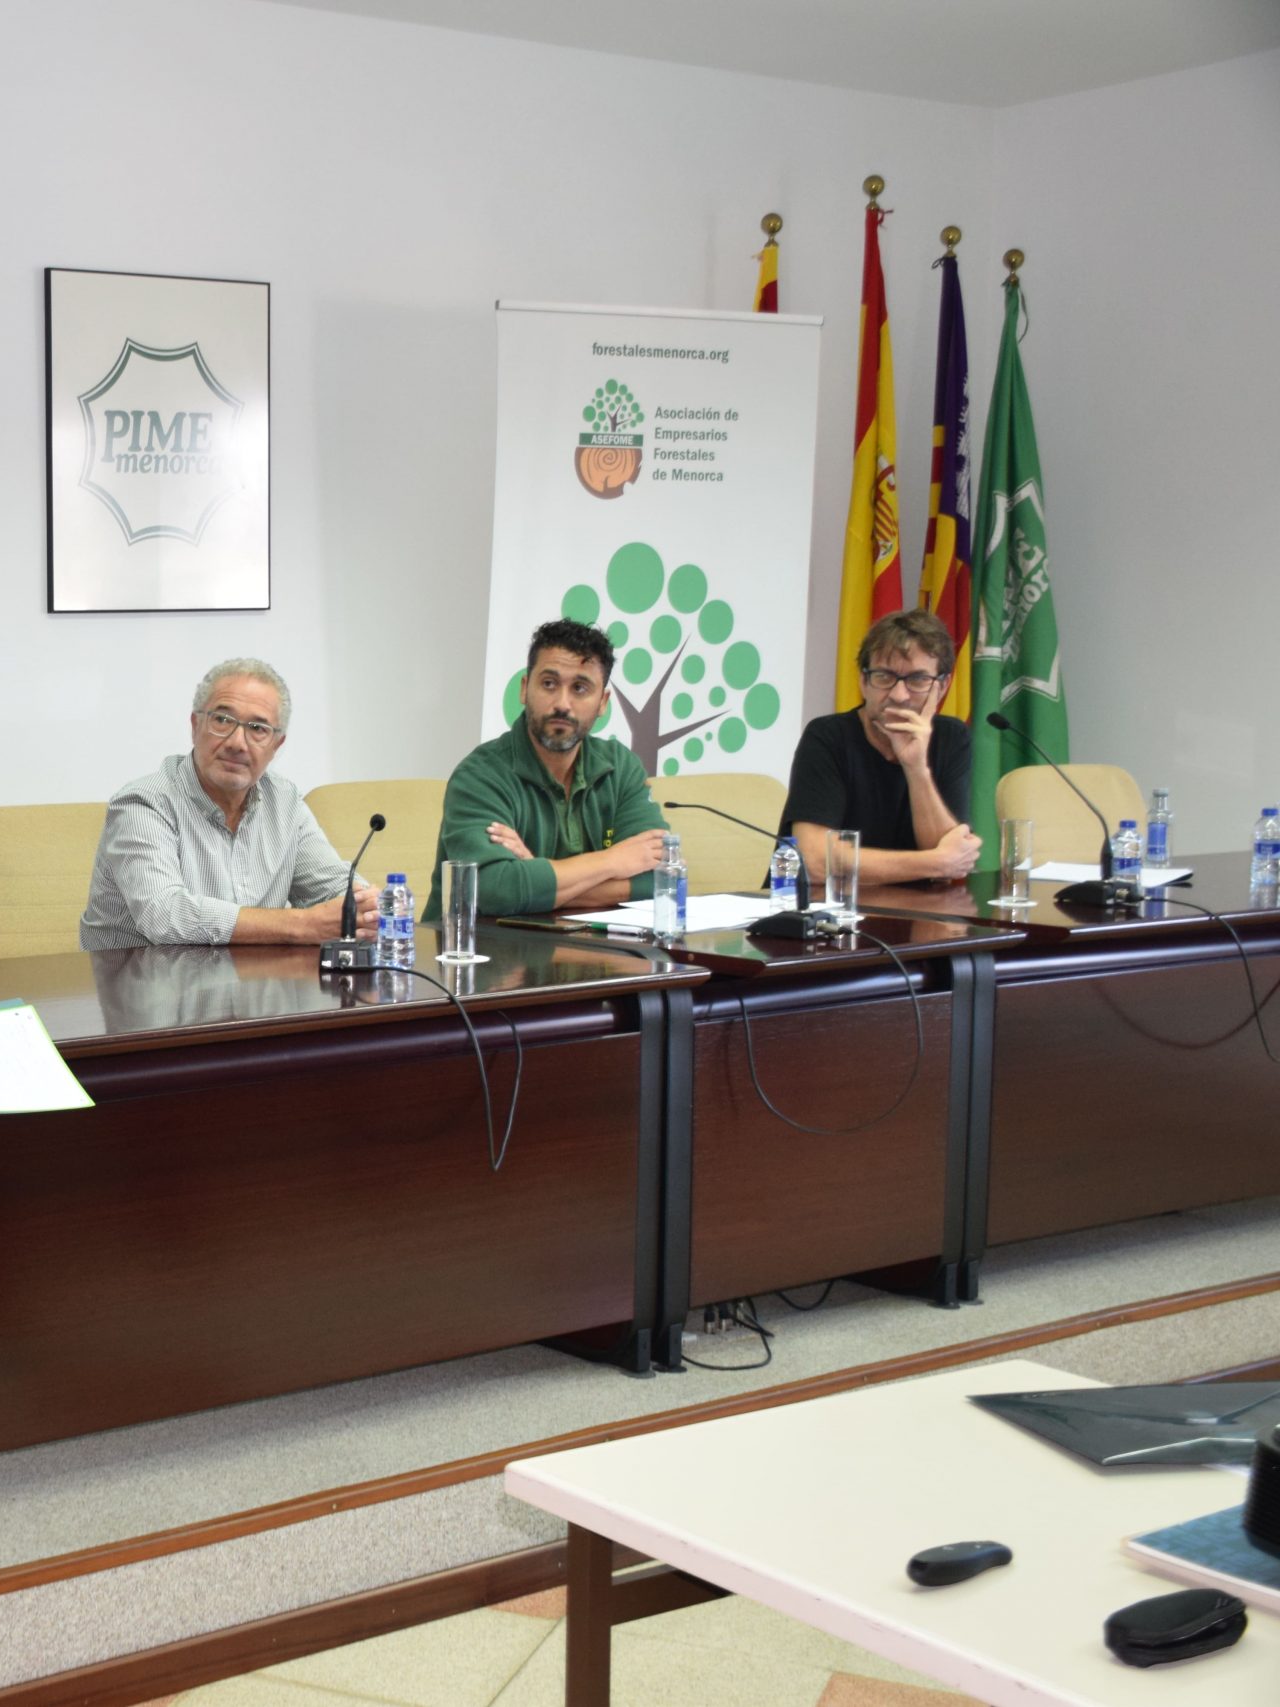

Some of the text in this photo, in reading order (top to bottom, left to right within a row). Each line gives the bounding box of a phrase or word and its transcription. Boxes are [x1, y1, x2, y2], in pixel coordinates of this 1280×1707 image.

[592, 342, 730, 363] forestalesmenorca.org
[654, 406, 739, 421] Asociación de
[101, 410, 214, 463] PIME
[590, 434, 634, 446] ASEFOME
[654, 427, 728, 442] Empresarios
[653, 448, 715, 462] Forestales
[652, 467, 724, 482] de Menorca
